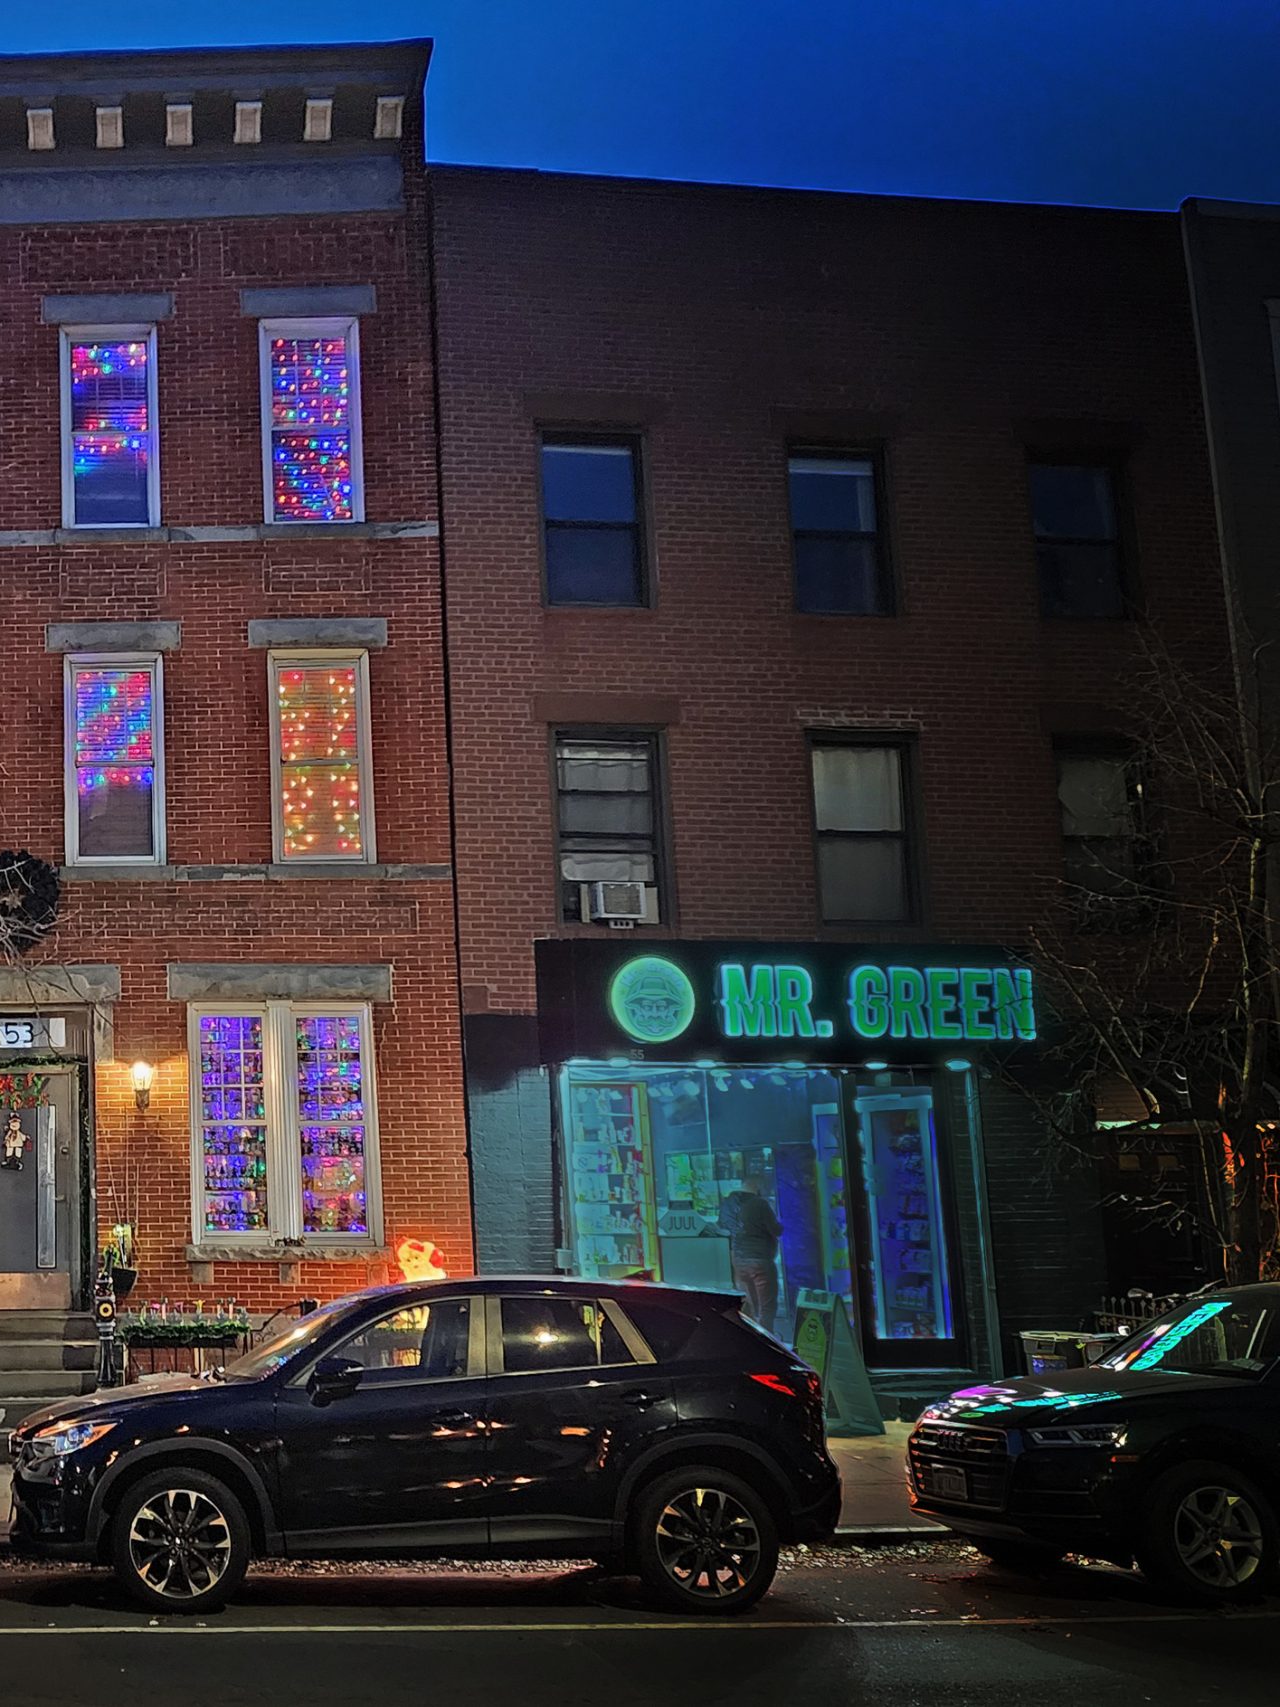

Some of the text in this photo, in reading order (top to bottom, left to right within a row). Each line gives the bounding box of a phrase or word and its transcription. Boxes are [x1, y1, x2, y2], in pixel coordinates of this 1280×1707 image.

[720, 964, 1037, 1040] MR. GREEN
[4, 1022, 34, 1044] 53
[630, 1048, 645, 1060] 55
[668, 1215, 697, 1231] JUUL
